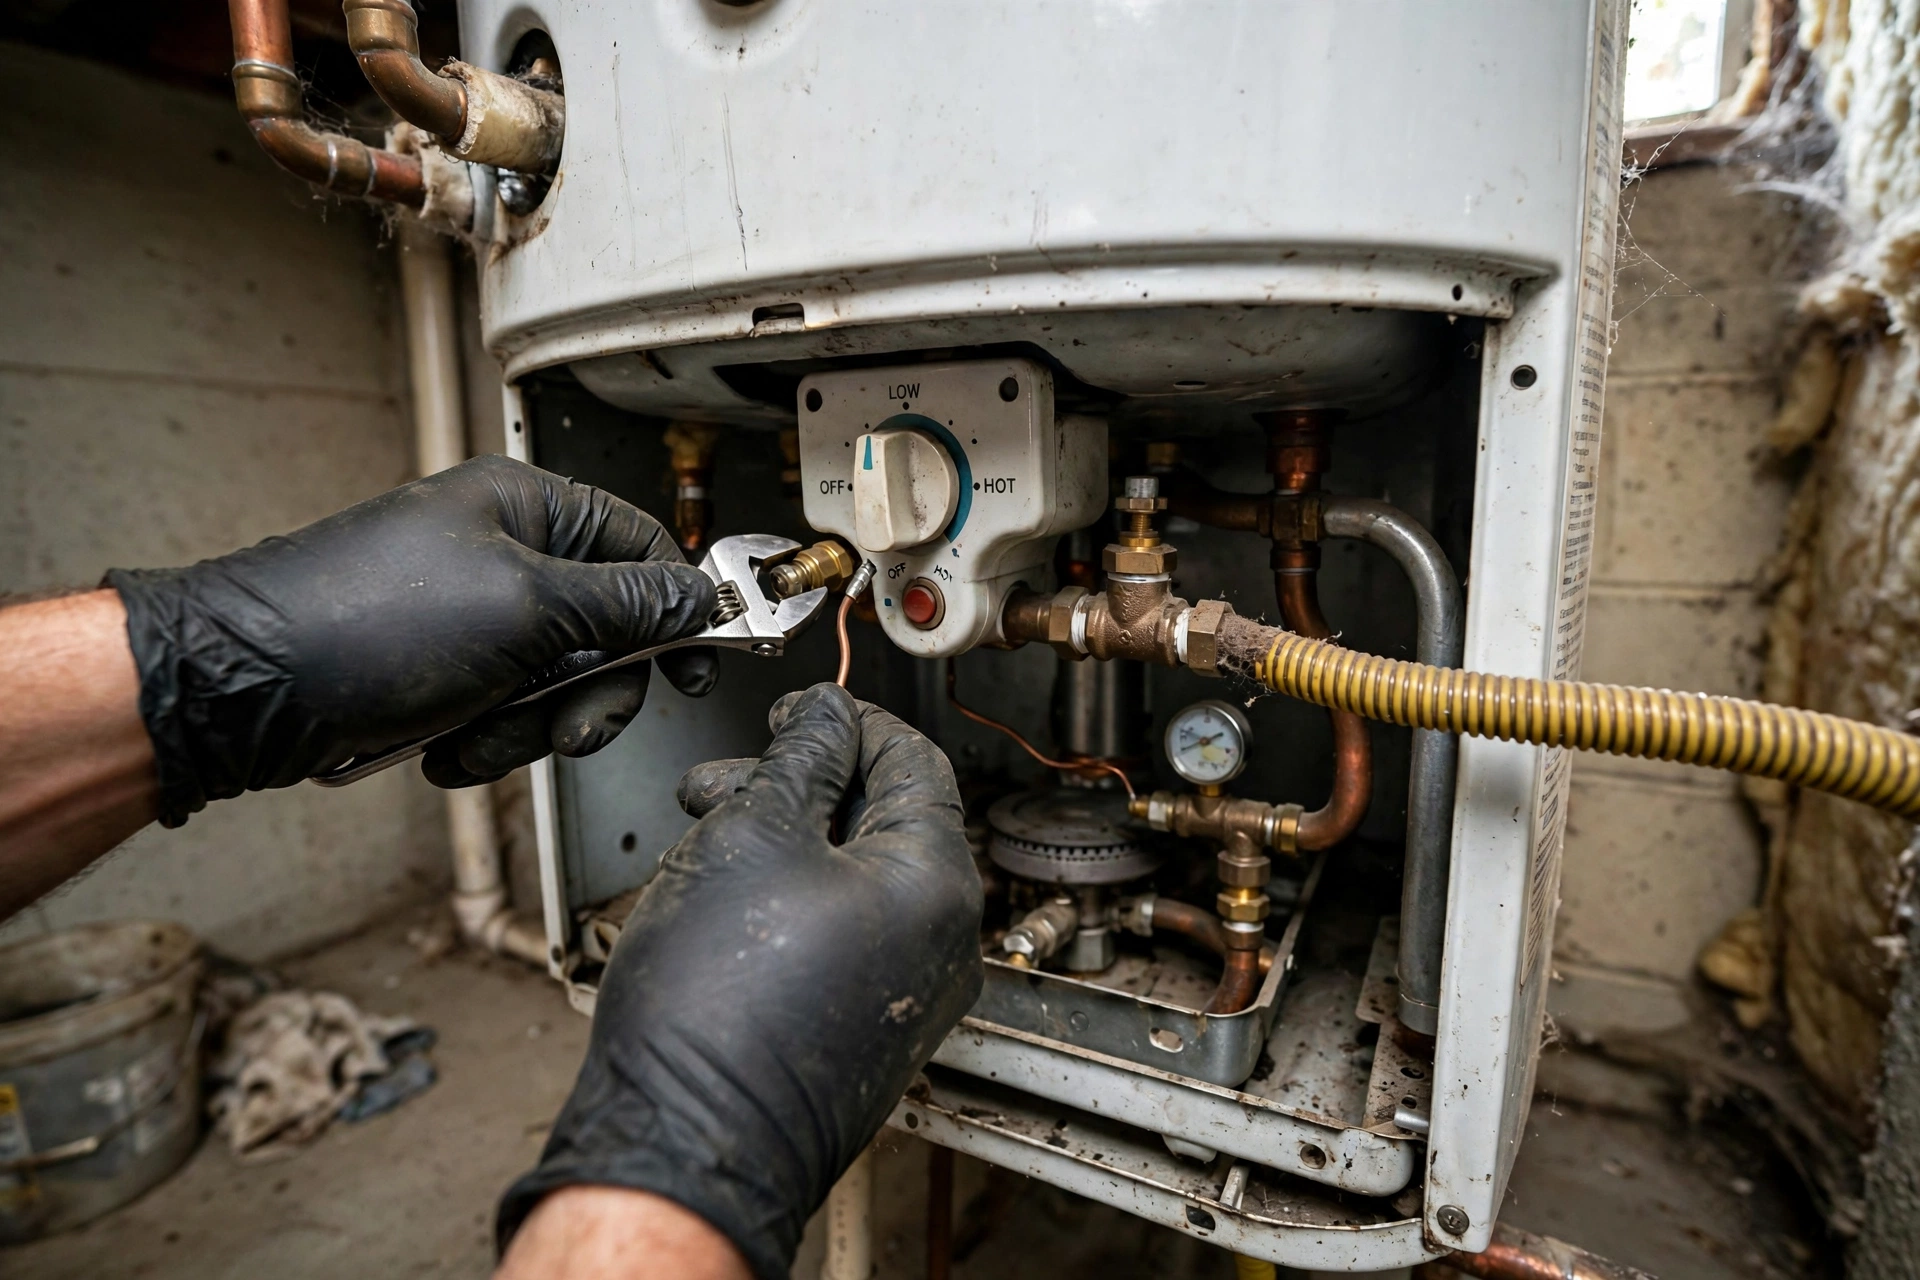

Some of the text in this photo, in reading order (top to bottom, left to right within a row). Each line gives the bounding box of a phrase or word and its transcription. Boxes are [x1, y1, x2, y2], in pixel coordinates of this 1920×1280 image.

[889, 383, 920, 400] LOW
[820, 480, 845, 495] OFF
[984, 478, 1016, 493] HOT
[888, 562, 906, 579] OFF
